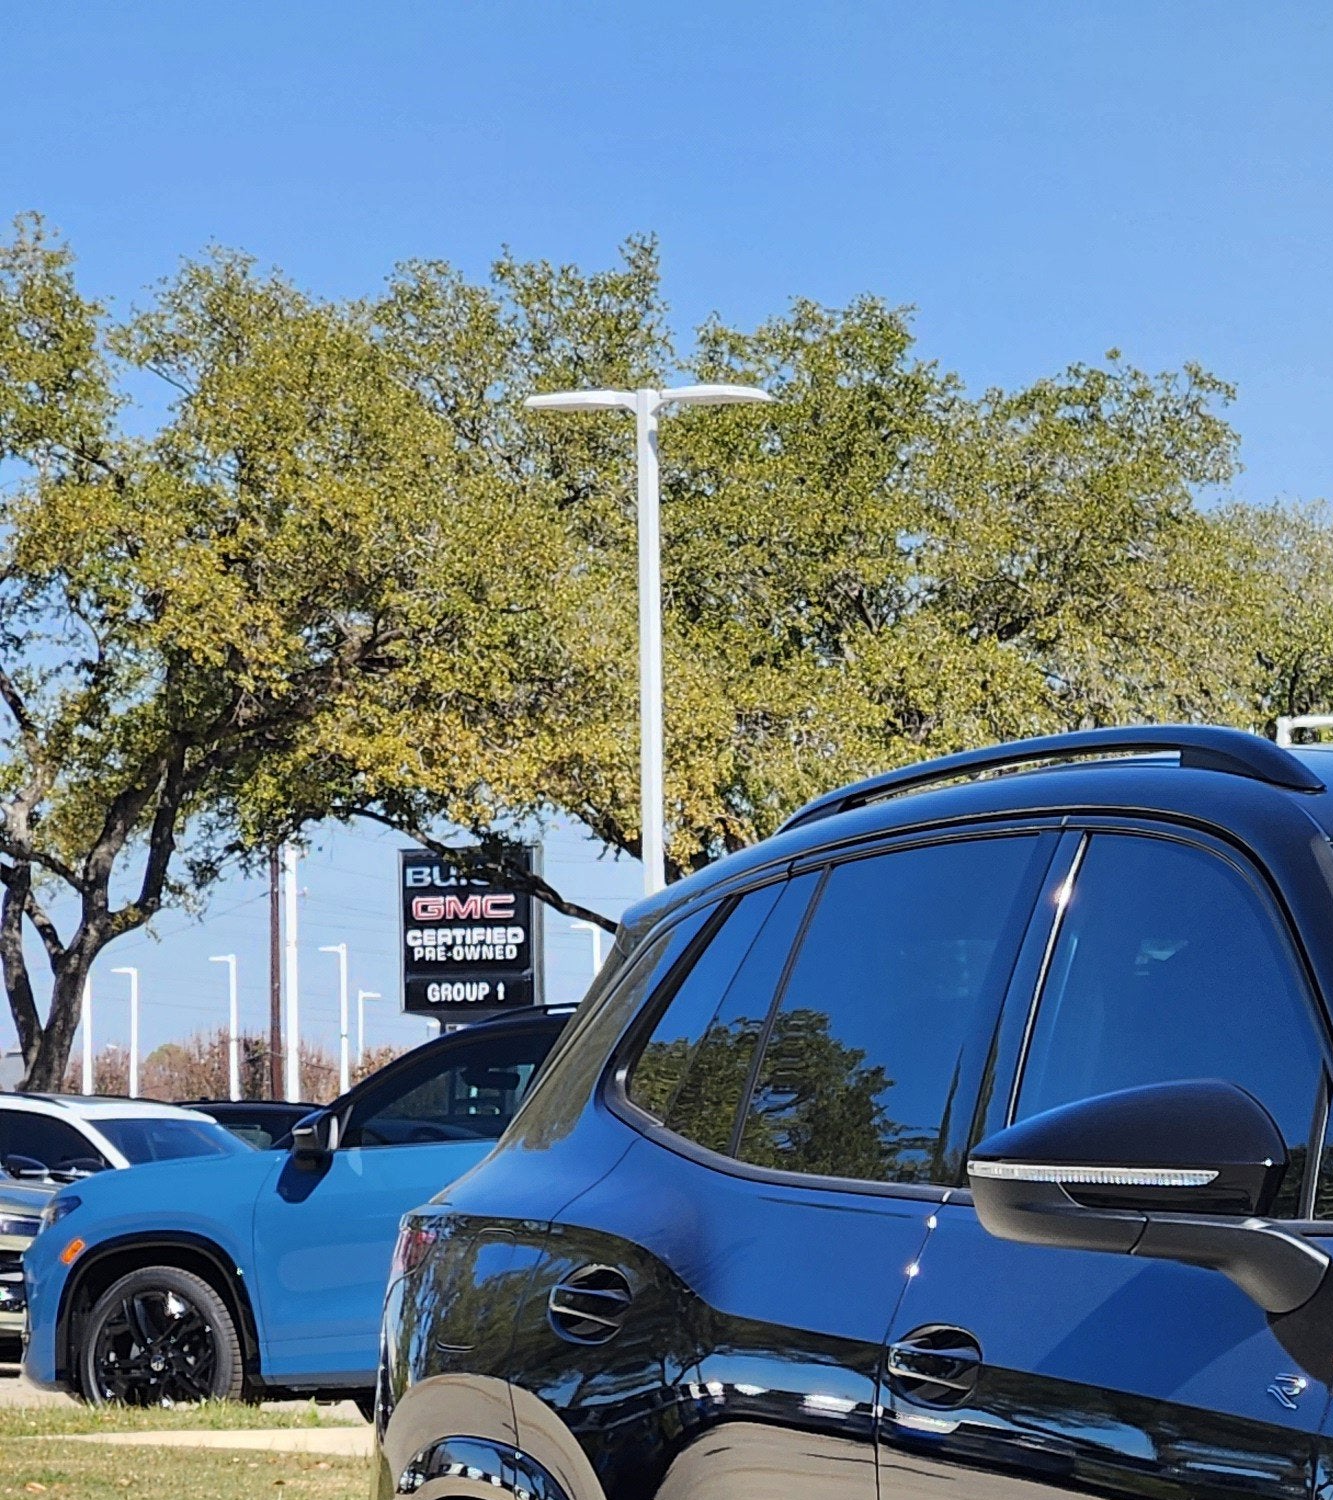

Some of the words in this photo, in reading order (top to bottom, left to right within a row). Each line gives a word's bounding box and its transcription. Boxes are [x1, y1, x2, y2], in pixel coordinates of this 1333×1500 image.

[412, 893, 515, 920] GMC
[406, 926, 525, 947] CERTIFIED
[413, 944, 518, 961] PRE-OWNED
[427, 982, 490, 1002] GROUP
[497, 981, 505, 1001] 1
